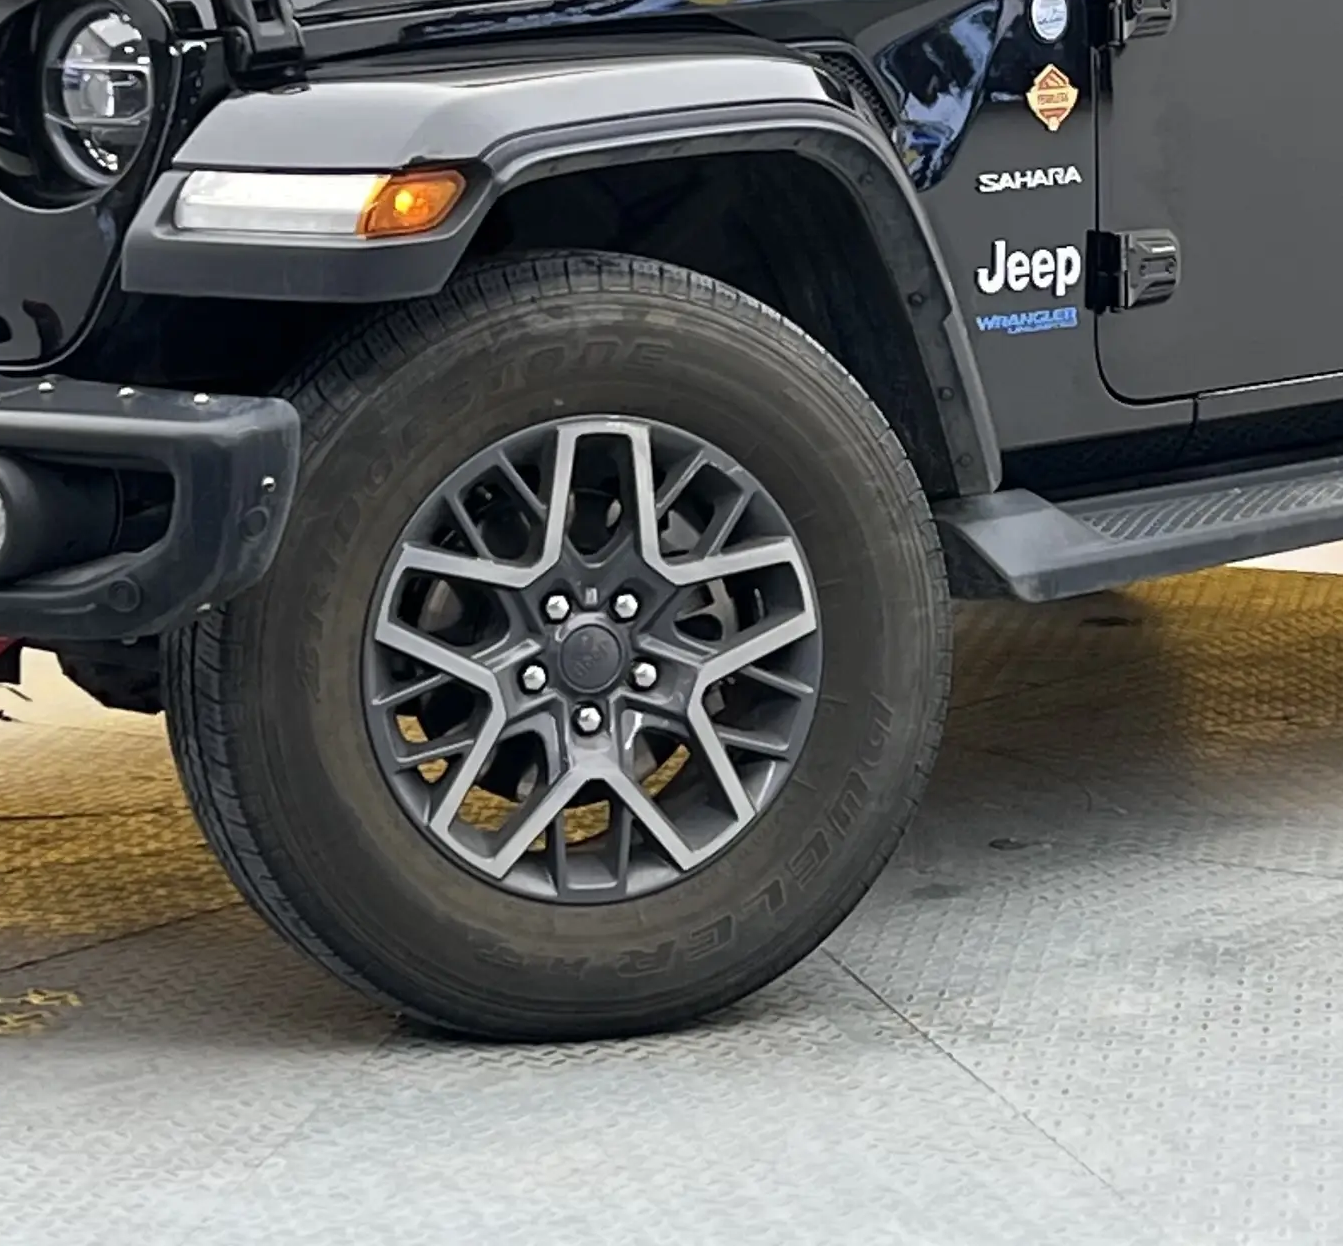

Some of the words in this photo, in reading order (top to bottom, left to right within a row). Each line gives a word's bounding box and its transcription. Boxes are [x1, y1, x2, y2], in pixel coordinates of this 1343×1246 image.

[976, 165, 1083, 193] SAHARA
[976, 240, 1081, 296] Jeep
[975, 306, 1078, 331] WRANGLER
[616, 690, 896, 979] DUELER
